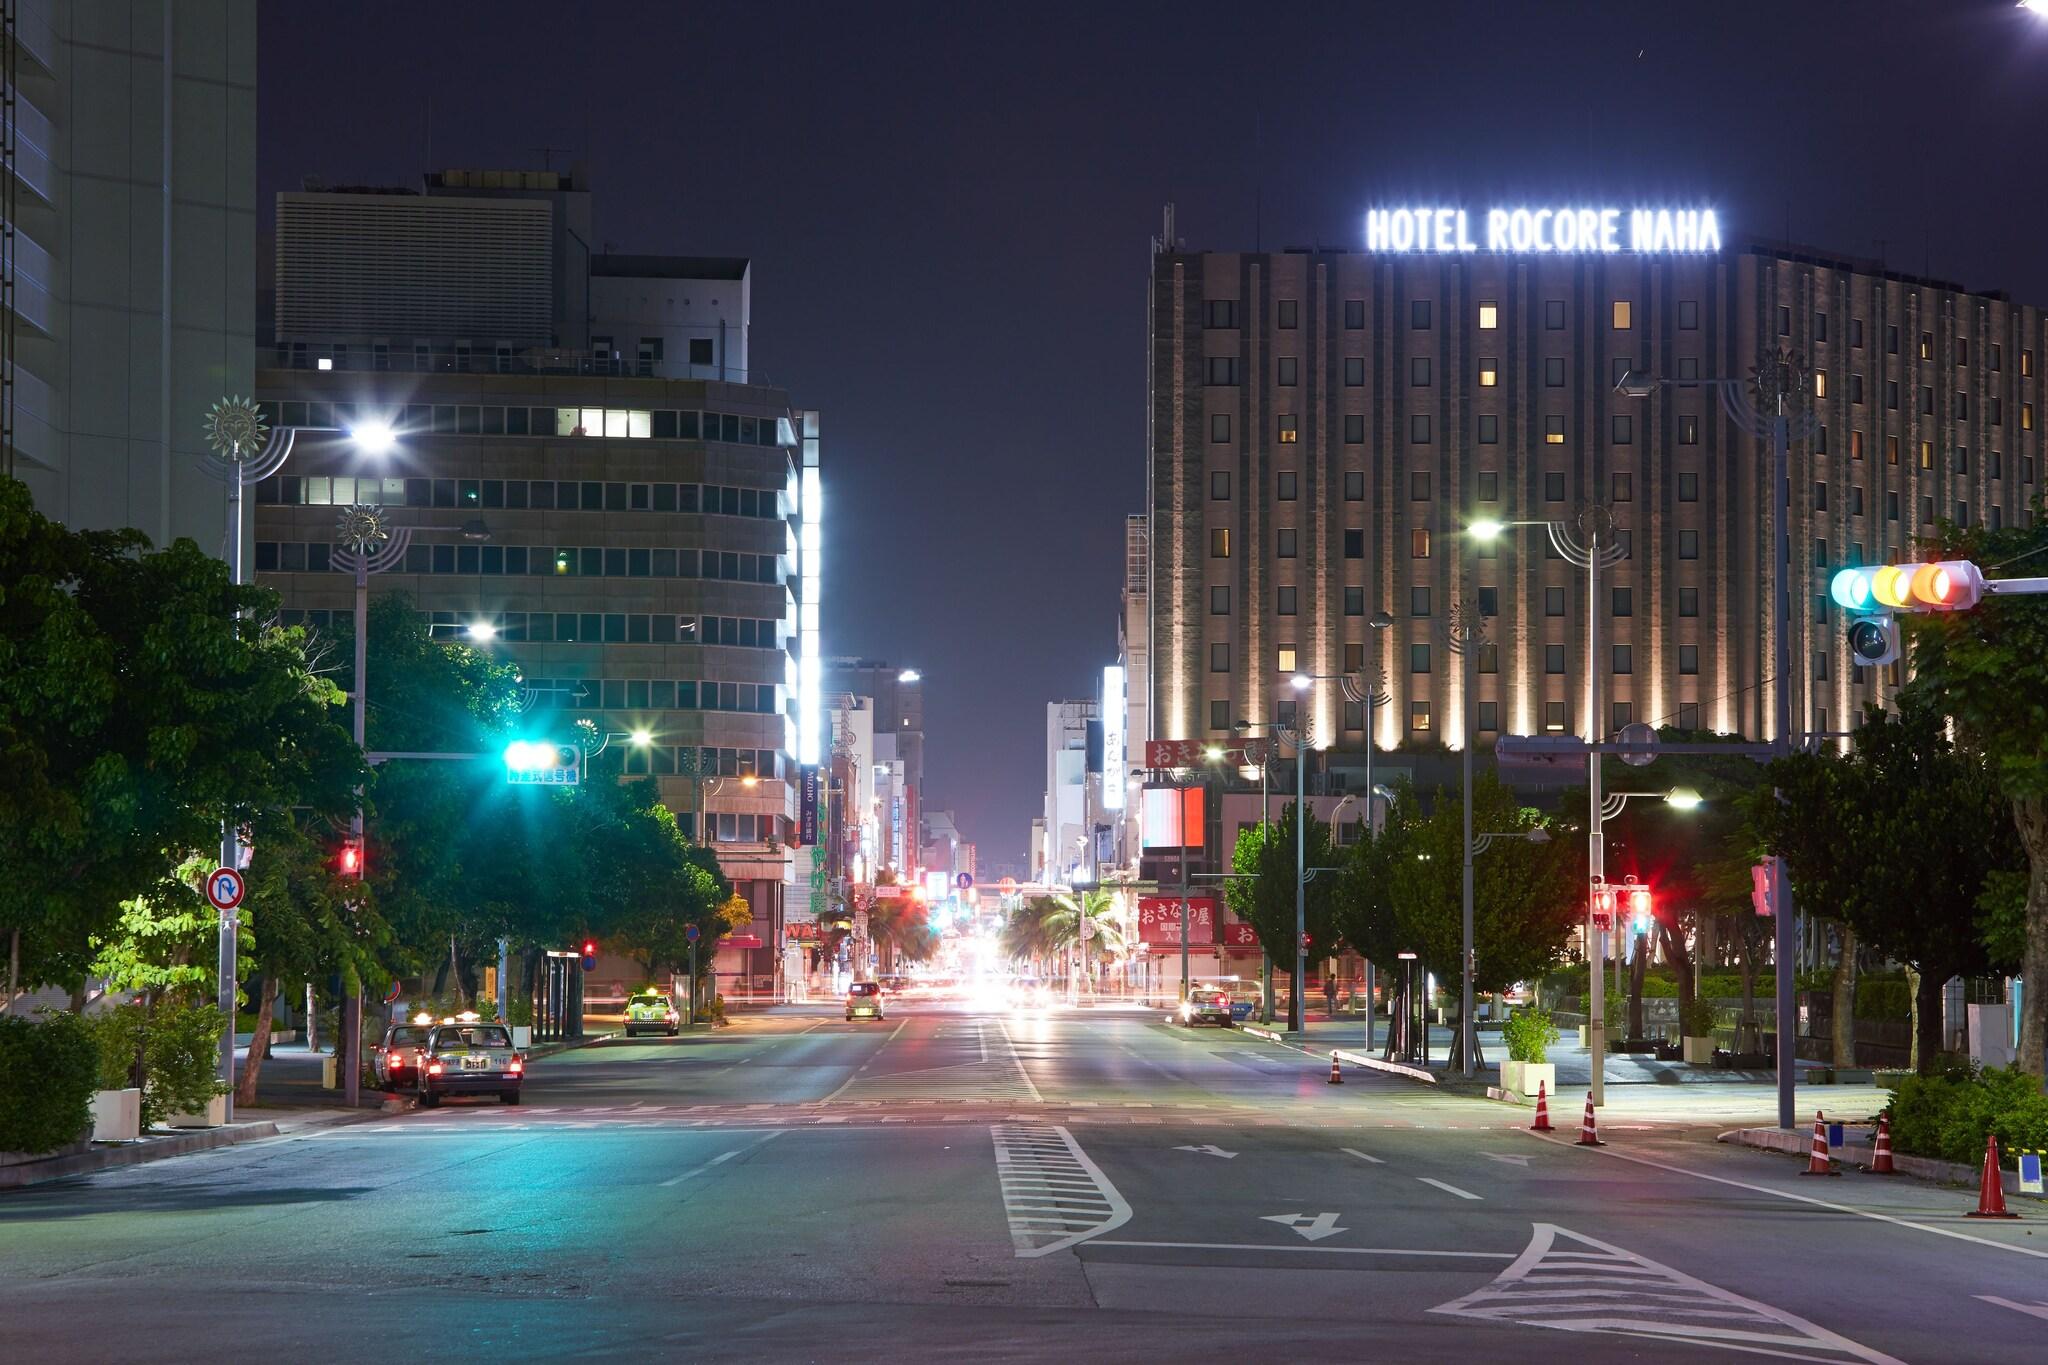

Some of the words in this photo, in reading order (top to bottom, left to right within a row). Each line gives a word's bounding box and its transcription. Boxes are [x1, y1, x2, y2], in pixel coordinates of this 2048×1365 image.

[1367, 208, 1477, 252] HOTEL
[1488, 208, 1621, 252] ROCORE
[1631, 208, 1721, 252] NAHA
[1142, 901, 1210, 925] おきなわ屋
